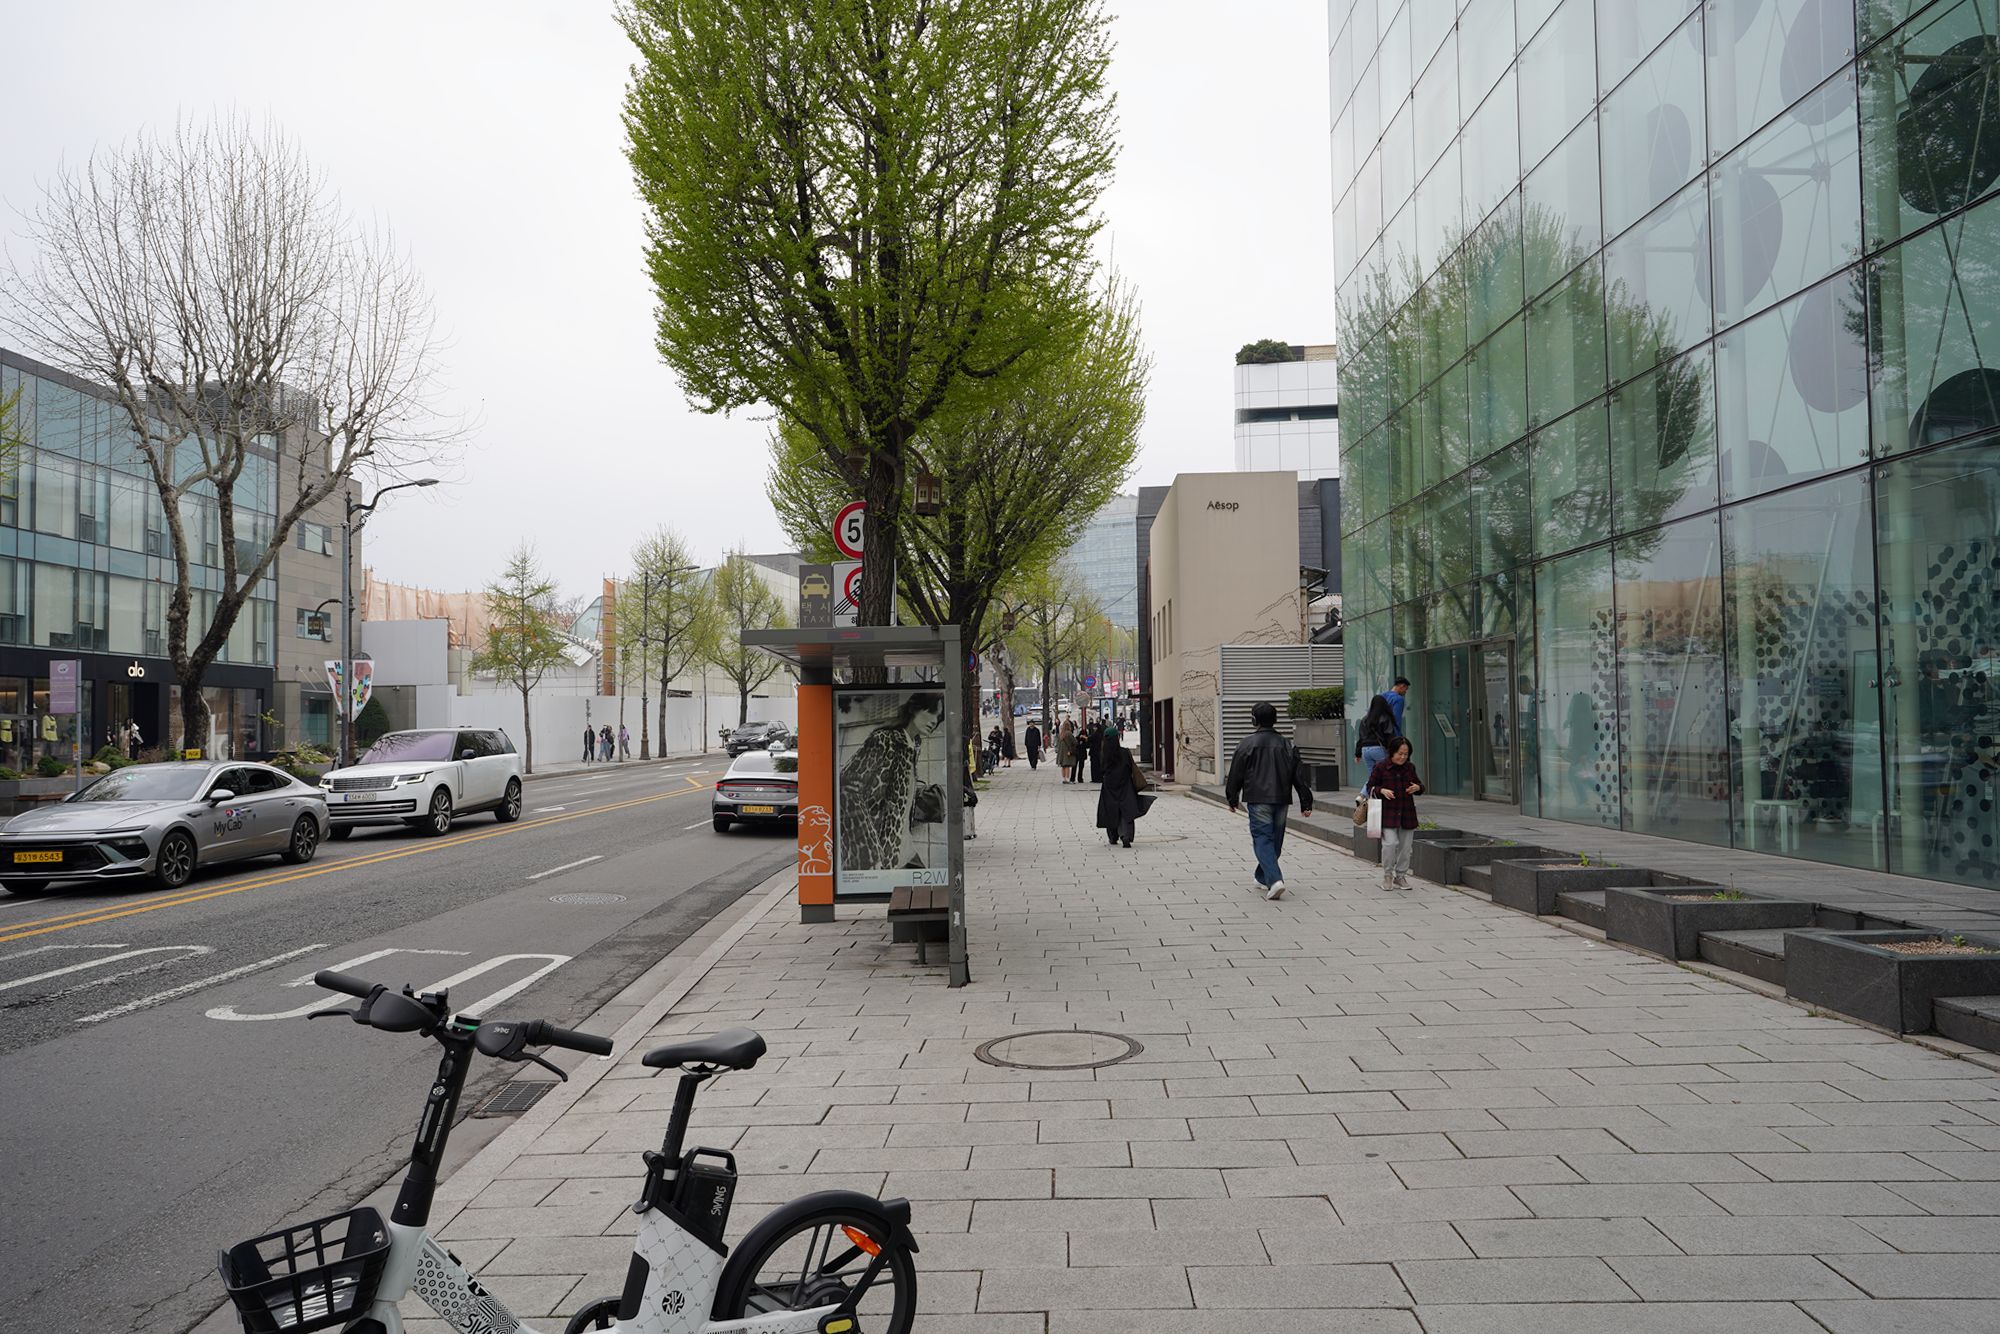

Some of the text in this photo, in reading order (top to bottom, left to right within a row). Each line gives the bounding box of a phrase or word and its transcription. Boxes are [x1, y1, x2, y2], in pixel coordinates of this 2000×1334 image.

[803, 615, 830, 623] TAXI
[128, 661, 145, 677] alo
[39, 853, 60, 862] 6543
[912, 871, 947, 884] R2W
